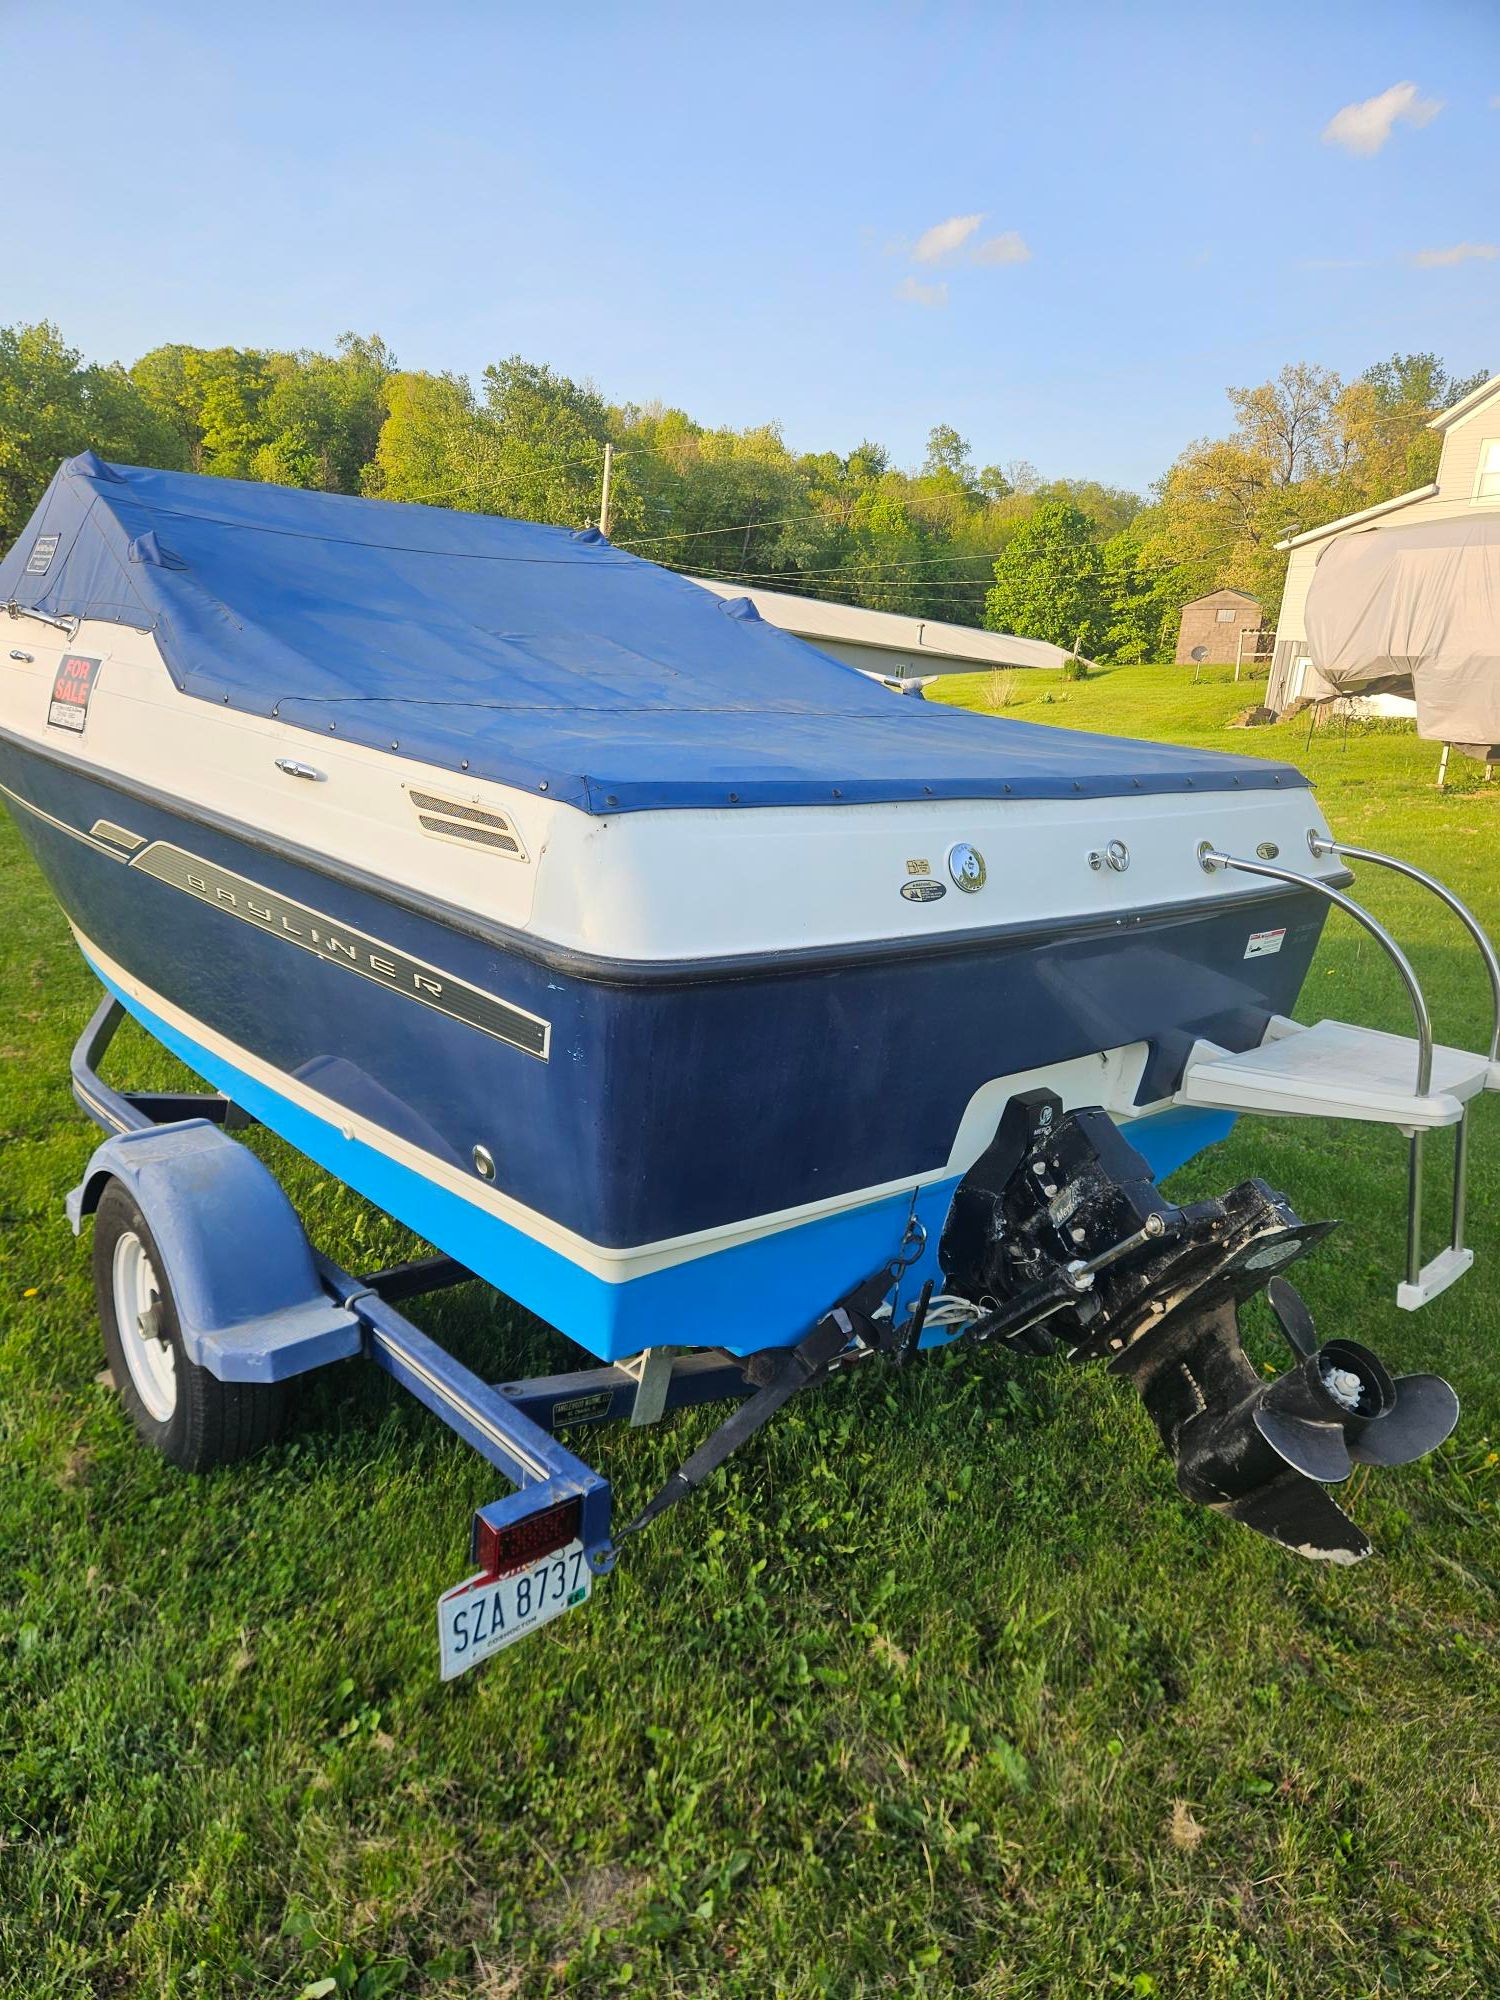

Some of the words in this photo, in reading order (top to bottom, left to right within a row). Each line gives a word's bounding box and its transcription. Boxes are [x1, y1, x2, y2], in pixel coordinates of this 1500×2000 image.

[54, 682, 90, 705] SALE
[64, 659, 91, 680] FOR
[186, 873, 443, 999] BAYLINER
[453, 1592, 505, 1653] SZA
[516, 1551, 583, 1618] 8737
